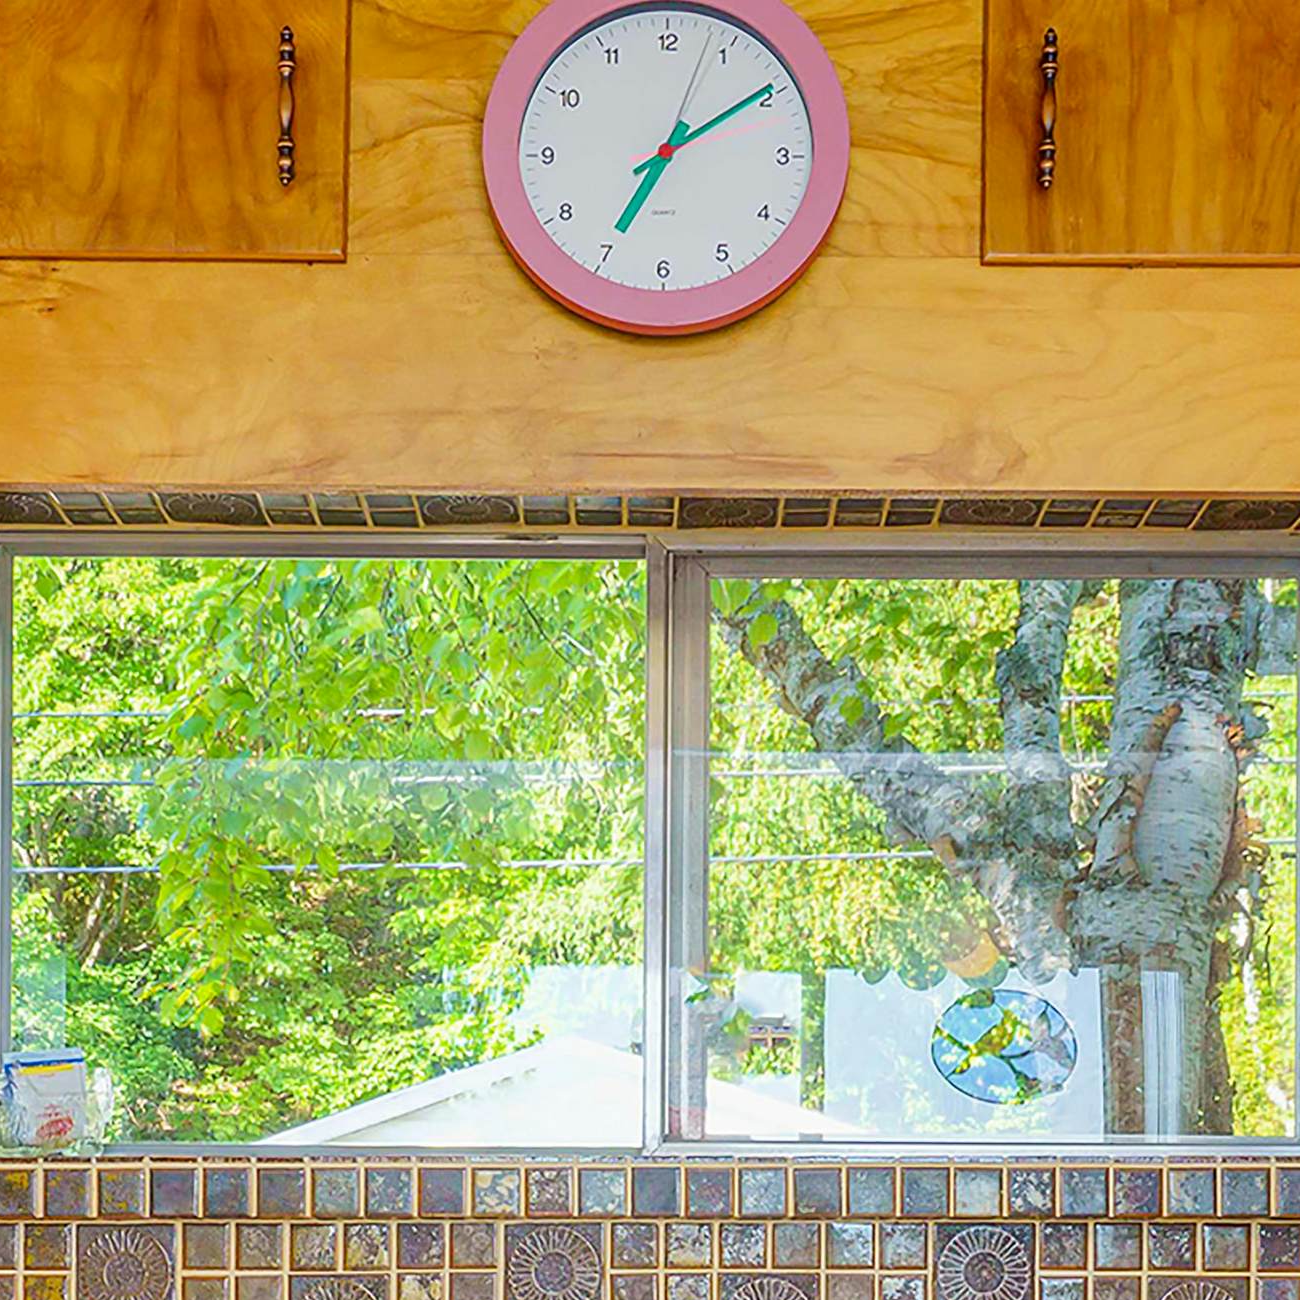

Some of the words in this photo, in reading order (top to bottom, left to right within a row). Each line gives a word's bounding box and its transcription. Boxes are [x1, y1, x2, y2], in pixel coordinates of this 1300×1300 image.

[657, 33, 679, 51] 12
[603, 48, 619, 65] 11
[718, 48, 727, 65] 1
[559, 89, 580, 108] 10
[758, 92, 773, 109] 2
[541, 146, 555, 165] 9
[775, 146, 790, 166] 3
[558, 203, 573, 221] 8
[756, 204, 770, 220] 4
[600, 244, 614, 263] 7
[715, 244, 730, 262] 5
[656, 260, 670, 278] 6
